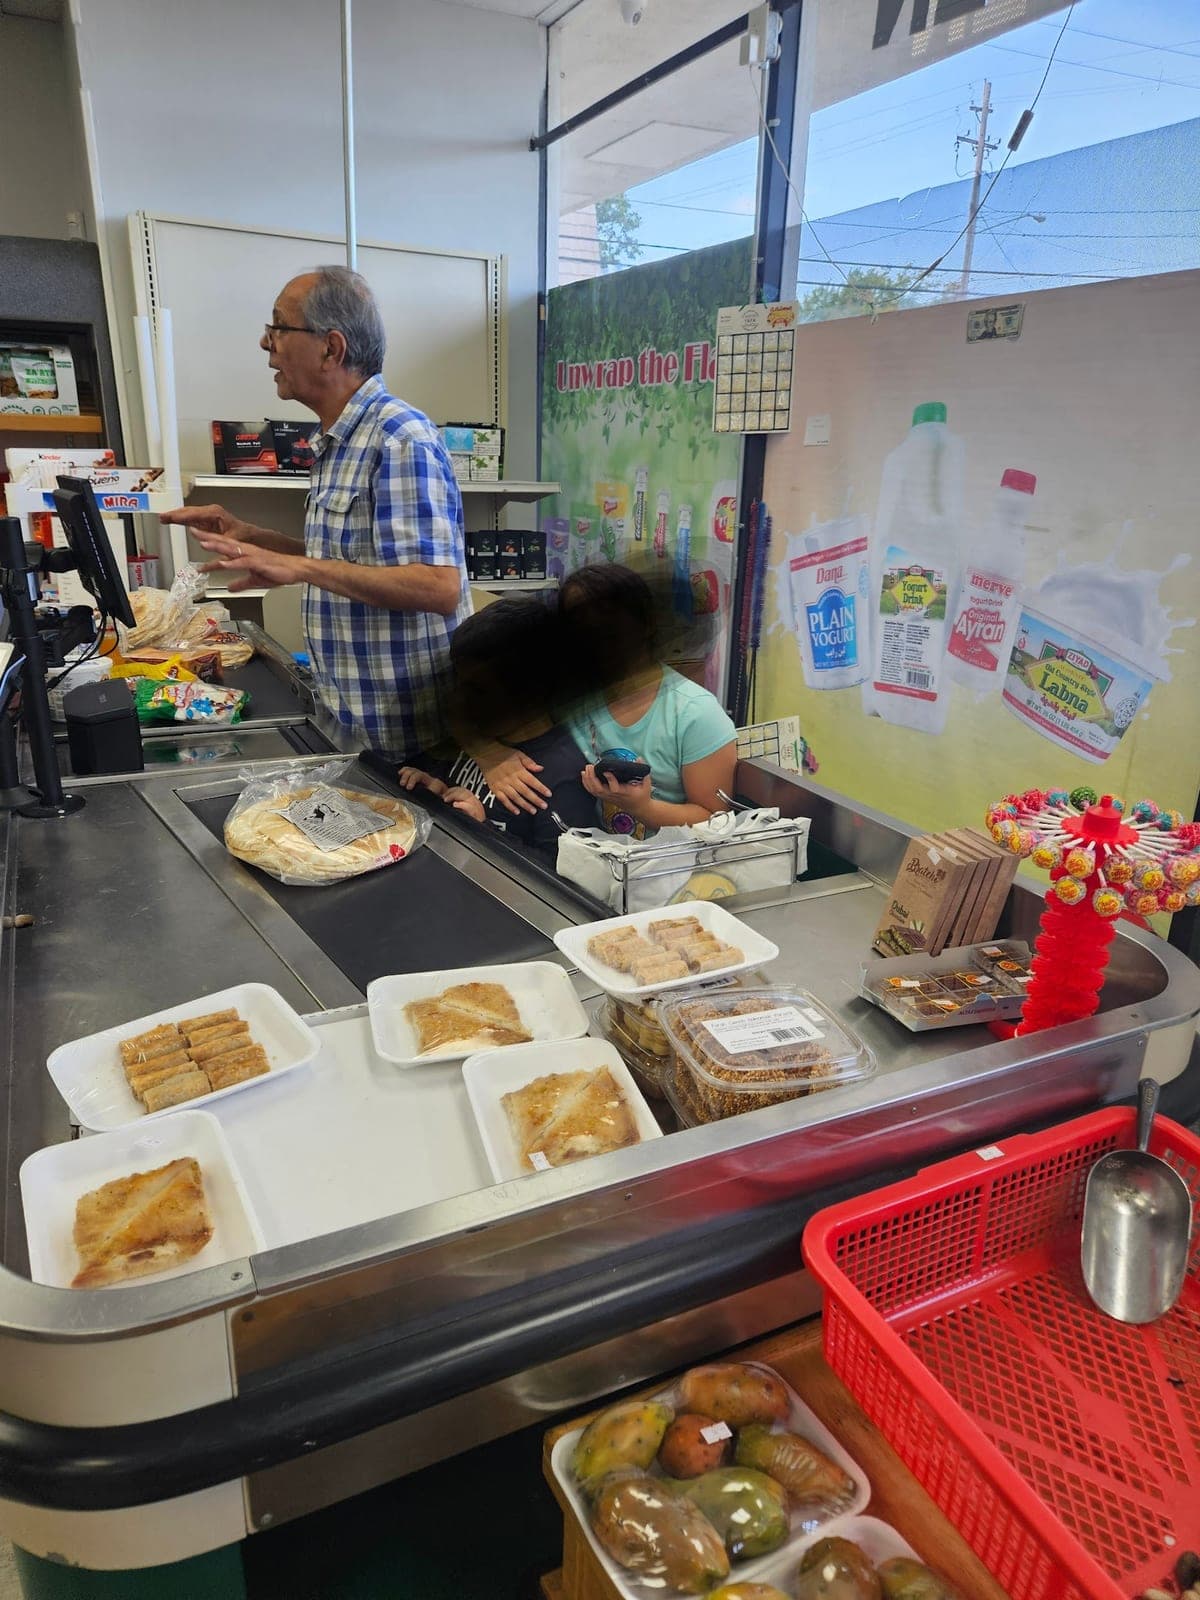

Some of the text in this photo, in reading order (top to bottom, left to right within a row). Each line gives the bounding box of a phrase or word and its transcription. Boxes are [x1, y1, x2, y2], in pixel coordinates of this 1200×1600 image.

[556, 355, 634, 392] Unwrap
[639, 348, 678, 385] the
[103, 496, 139, 508] MIRA
[816, 565, 844, 584] Dana
[903, 581, 928, 594] Yogurt
[971, 574, 1012, 597] merve
[903, 593, 923, 604] Drink
[970, 596, 1003, 606] Yogurt Drink
[809, 607, 855, 631] PLAIN
[968, 610, 998, 623] Original
[812, 627, 855, 647] YOGURT
[956, 614, 1005, 641] Ayran
[1067, 651, 1090, 668] ZIYAD
[1045, 663, 1055, 674] Old
[1055, 669, 1080, 689] Country
[1039, 671, 1089, 714] Labna
